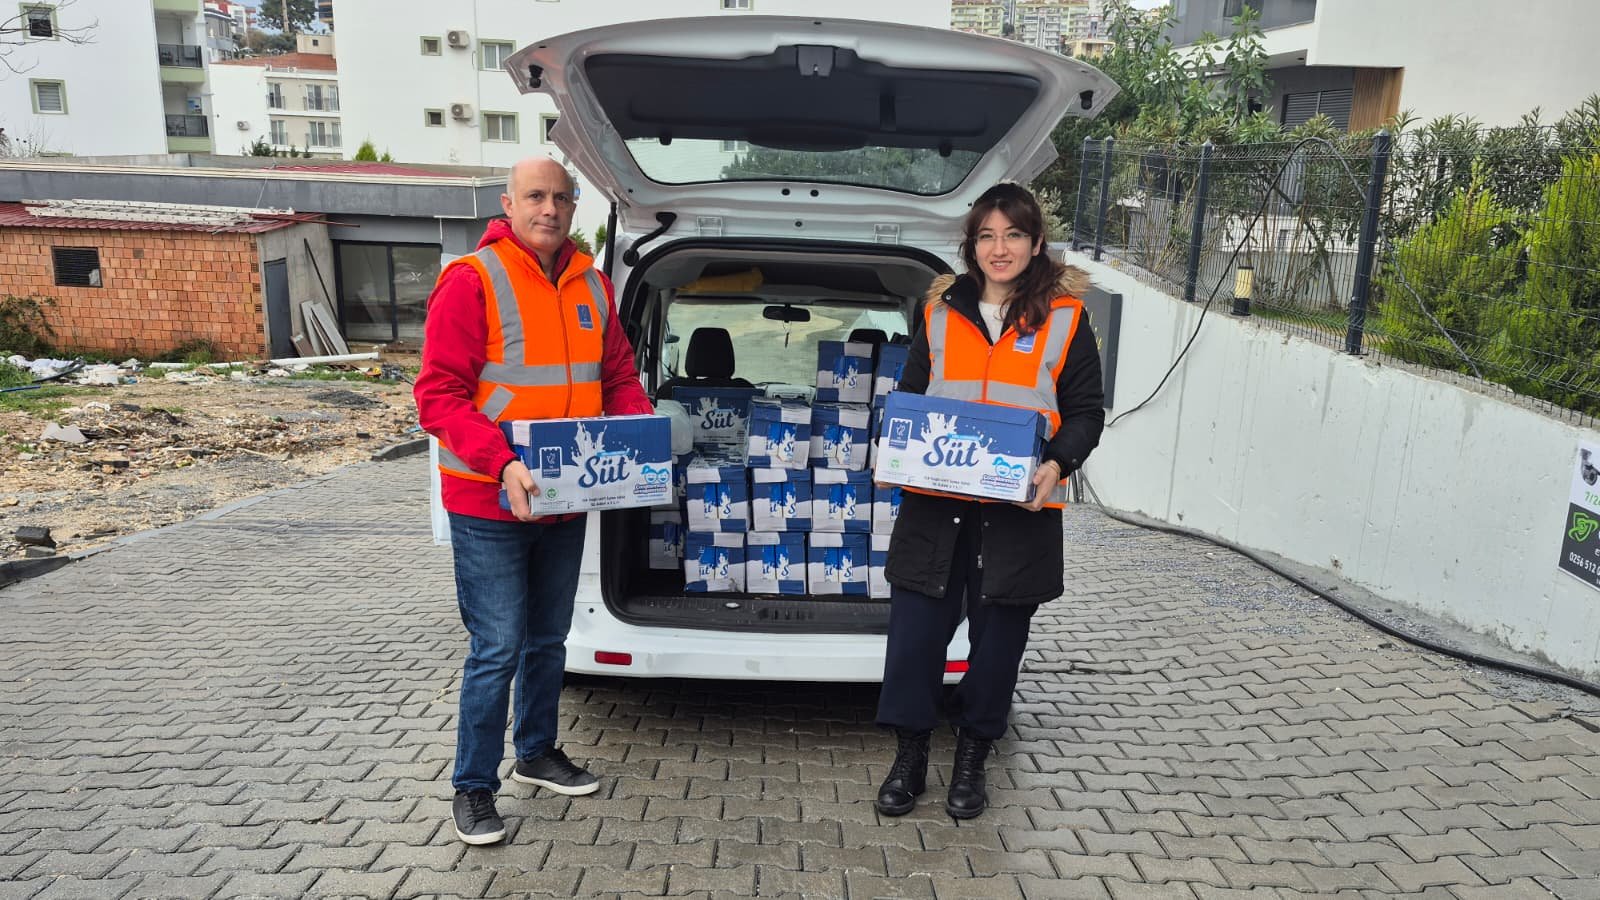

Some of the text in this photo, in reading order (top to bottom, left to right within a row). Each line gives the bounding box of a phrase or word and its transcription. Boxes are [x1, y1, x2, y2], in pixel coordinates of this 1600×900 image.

[701, 410, 735, 430] Süt
[923, 436, 980, 467] Süt
[578, 455, 630, 489] Süt
[1569, 551, 1584, 567] 0256
[1584, 559, 1597, 574] 512
